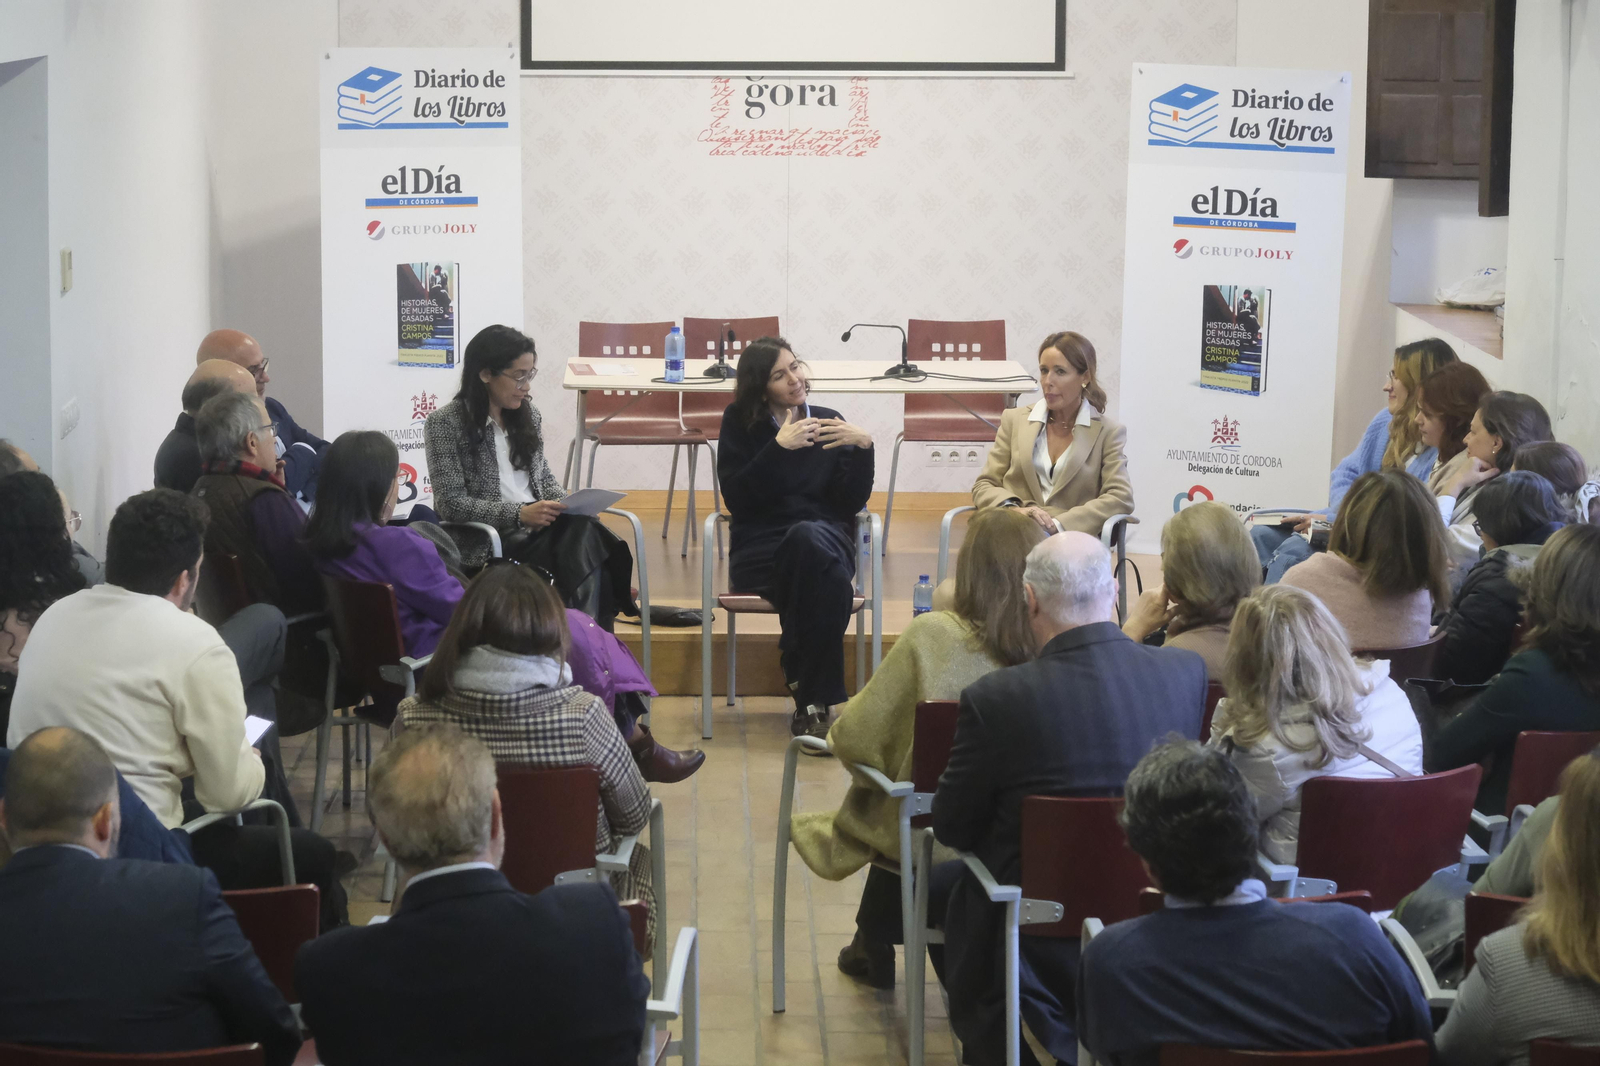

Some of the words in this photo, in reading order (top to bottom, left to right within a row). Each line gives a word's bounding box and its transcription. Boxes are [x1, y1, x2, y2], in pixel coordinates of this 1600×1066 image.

[414, 68, 479, 88] Diario
[483, 69, 506, 88] de
[1231, 88, 1304, 111] Diario
[1308, 92, 1334, 112] de
[413, 97, 442, 118] los
[447, 95, 506, 125] Libros
[1229, 117, 1261, 139] los
[1267, 117, 1333, 148] Libros
[1209, 219, 1219, 227] DE
[1221, 218, 1259, 228] CÓRDOBA
[401, 307, 411, 315] DE
[411, 306, 444, 315] MUJERES
[401, 324, 434, 332] CRISTINA
[401, 332, 432, 340] CAMPOS
[1205, 329, 1216, 337] DE
[1217, 330, 1252, 340] MUJERES
[1205, 337, 1241, 347] CASADAS
[1205, 346, 1240, 356] CRISTINA
[1204, 355, 1238, 364] CAMPOS
[397, 441, 425, 452] elegación
[1166, 449, 1228, 464] AYUNTAMIENTO
[1230, 454, 1240, 465] DE
[1188, 463, 1223, 475] Delegación
[1225, 466, 1234, 475] de
[1235, 466, 1260, 477] Cultura
